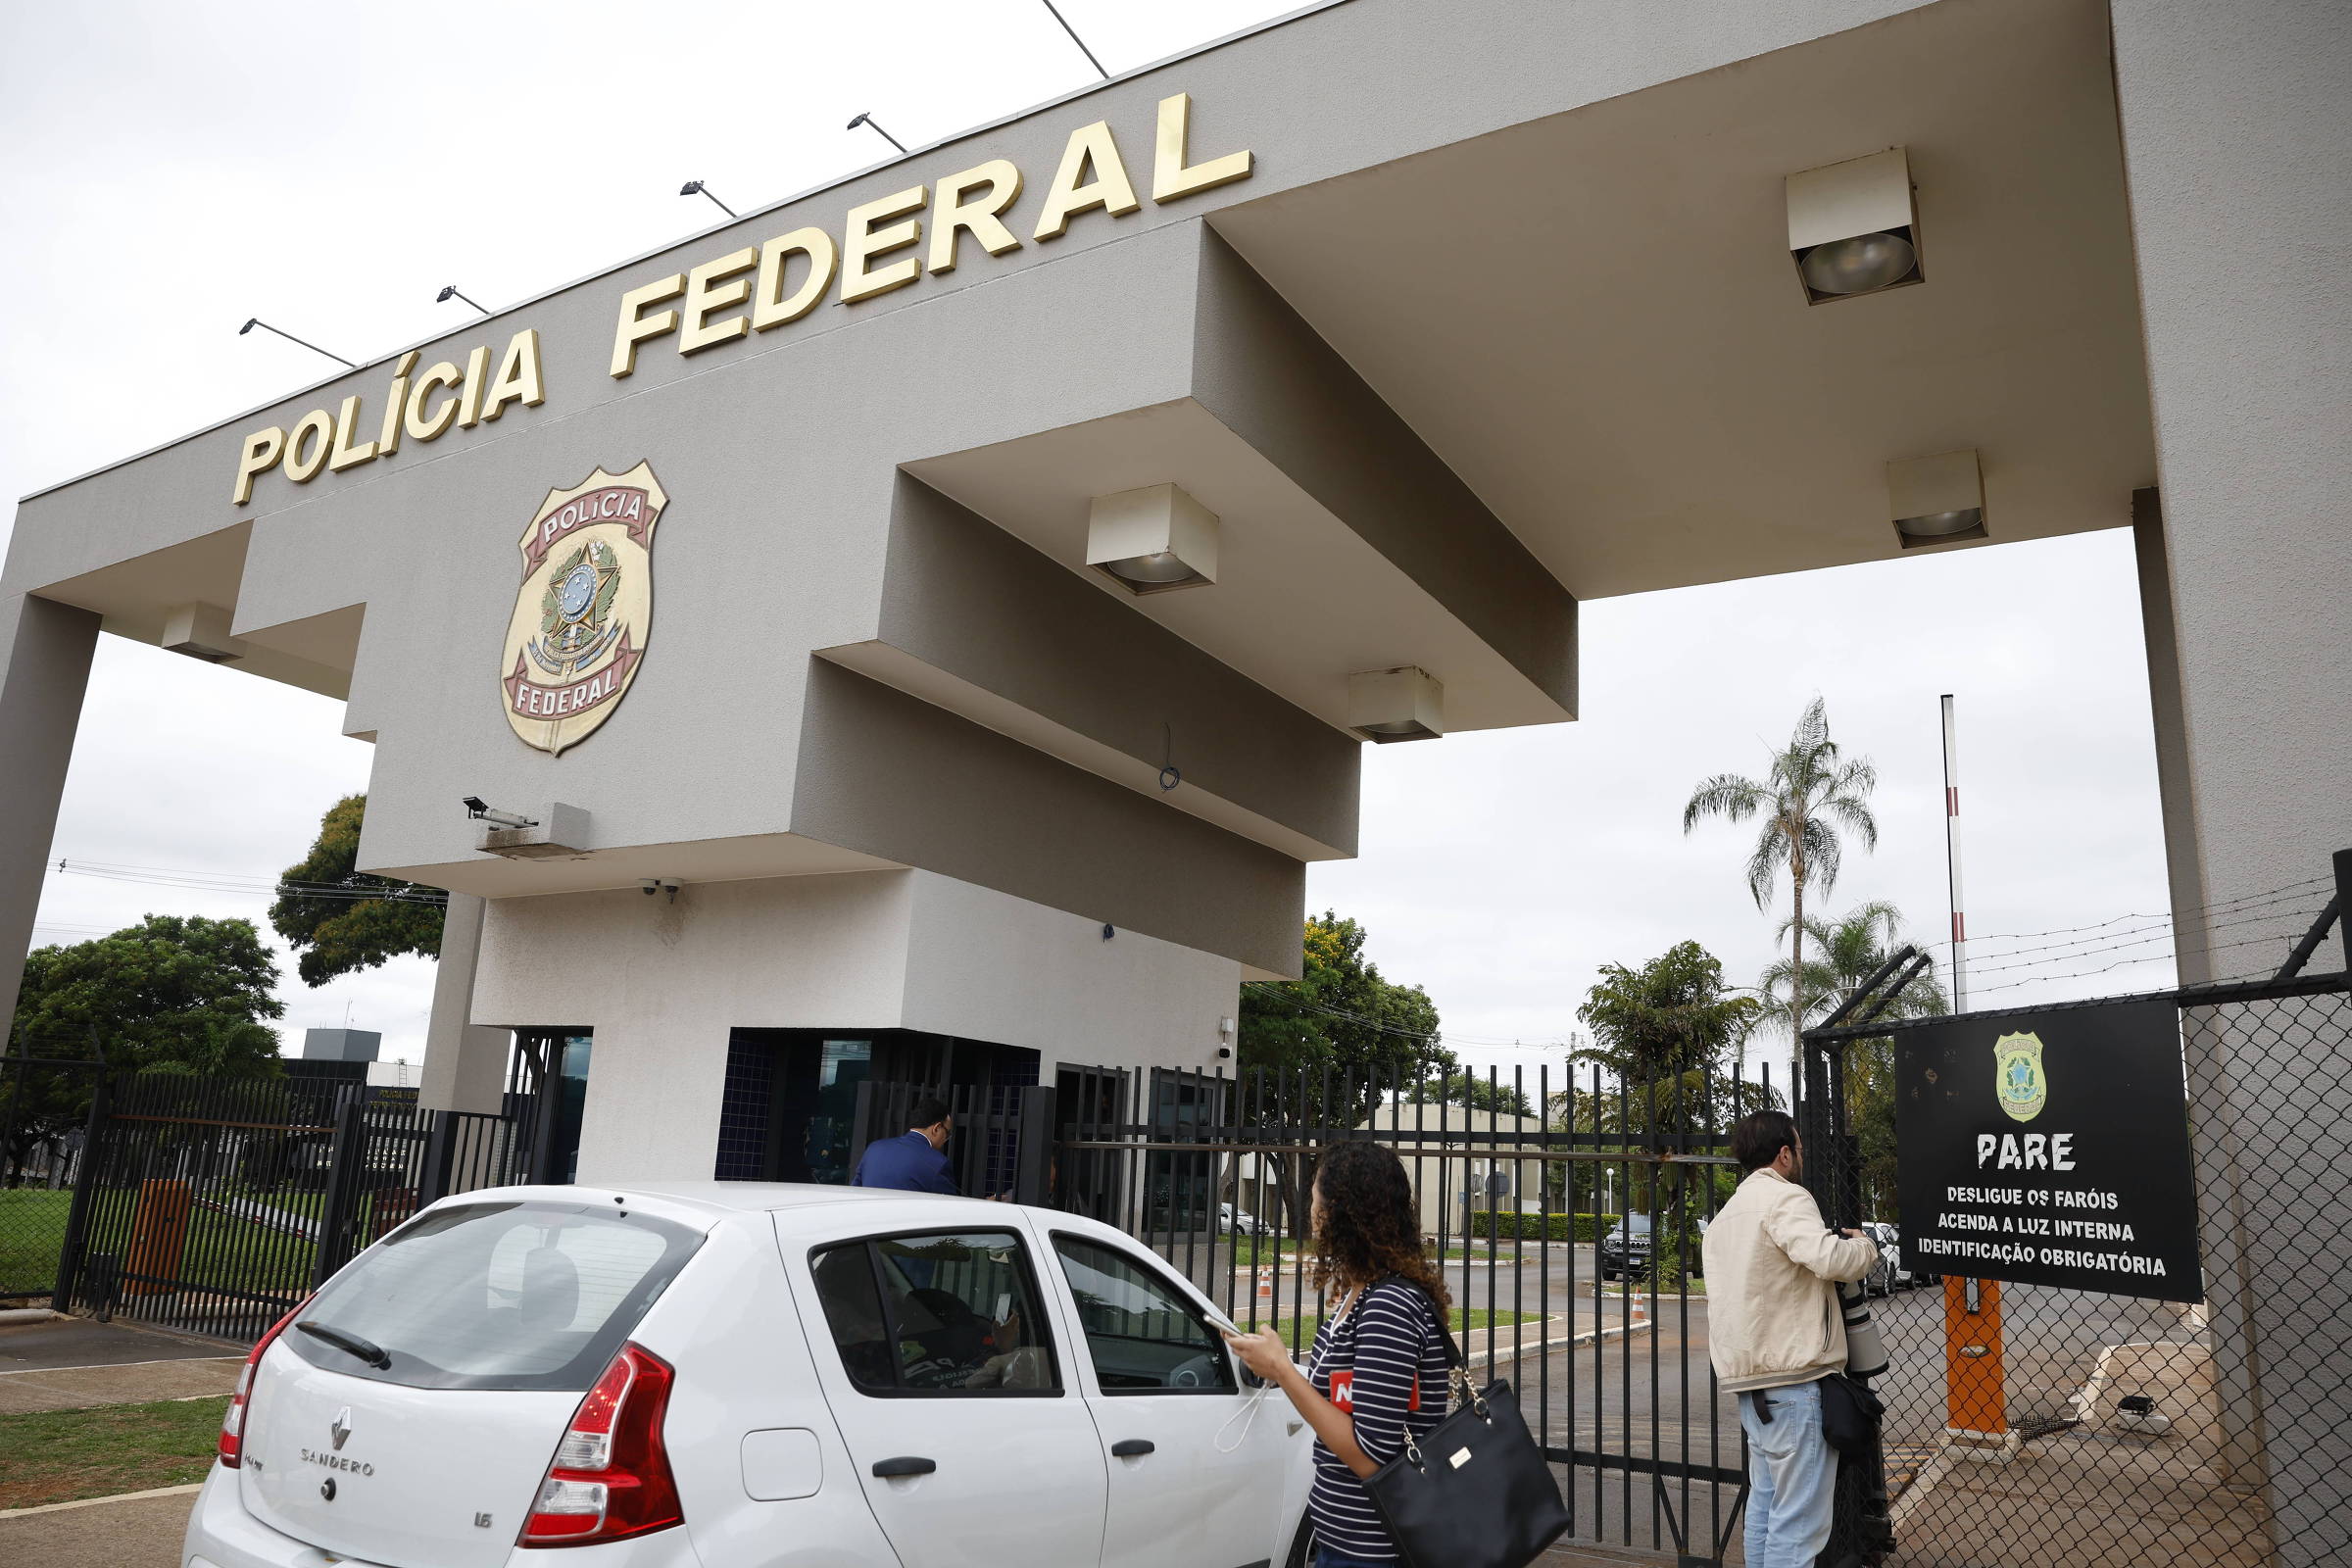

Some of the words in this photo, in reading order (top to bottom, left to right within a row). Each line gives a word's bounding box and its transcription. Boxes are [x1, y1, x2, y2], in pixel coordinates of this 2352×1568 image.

[232, 329, 545, 506] POLÍCIA
[609, 91, 1252, 378] FEDERAL
[516, 670, 616, 715] FEDERAL
[1978, 1133, 2076, 1171] PARE
[1947, 1186, 2022, 1206] DESLIGUE
[2027, 1190, 2049, 1206] OS
[2055, 1189, 2119, 1210] FARÓIS
[1937, 1213, 1998, 1232] ACENDA
[2002, 1215, 2014, 1233] A
[2018, 1217, 2050, 1237] LUZ
[2055, 1220, 2134, 1242] INTERNA
[1918, 1238, 2035, 1265] IDENTIFICAÇÃO
[2039, 1248, 2166, 1277] OBRIGATÓRIA
[300, 1448, 375, 1477] SANDERO
